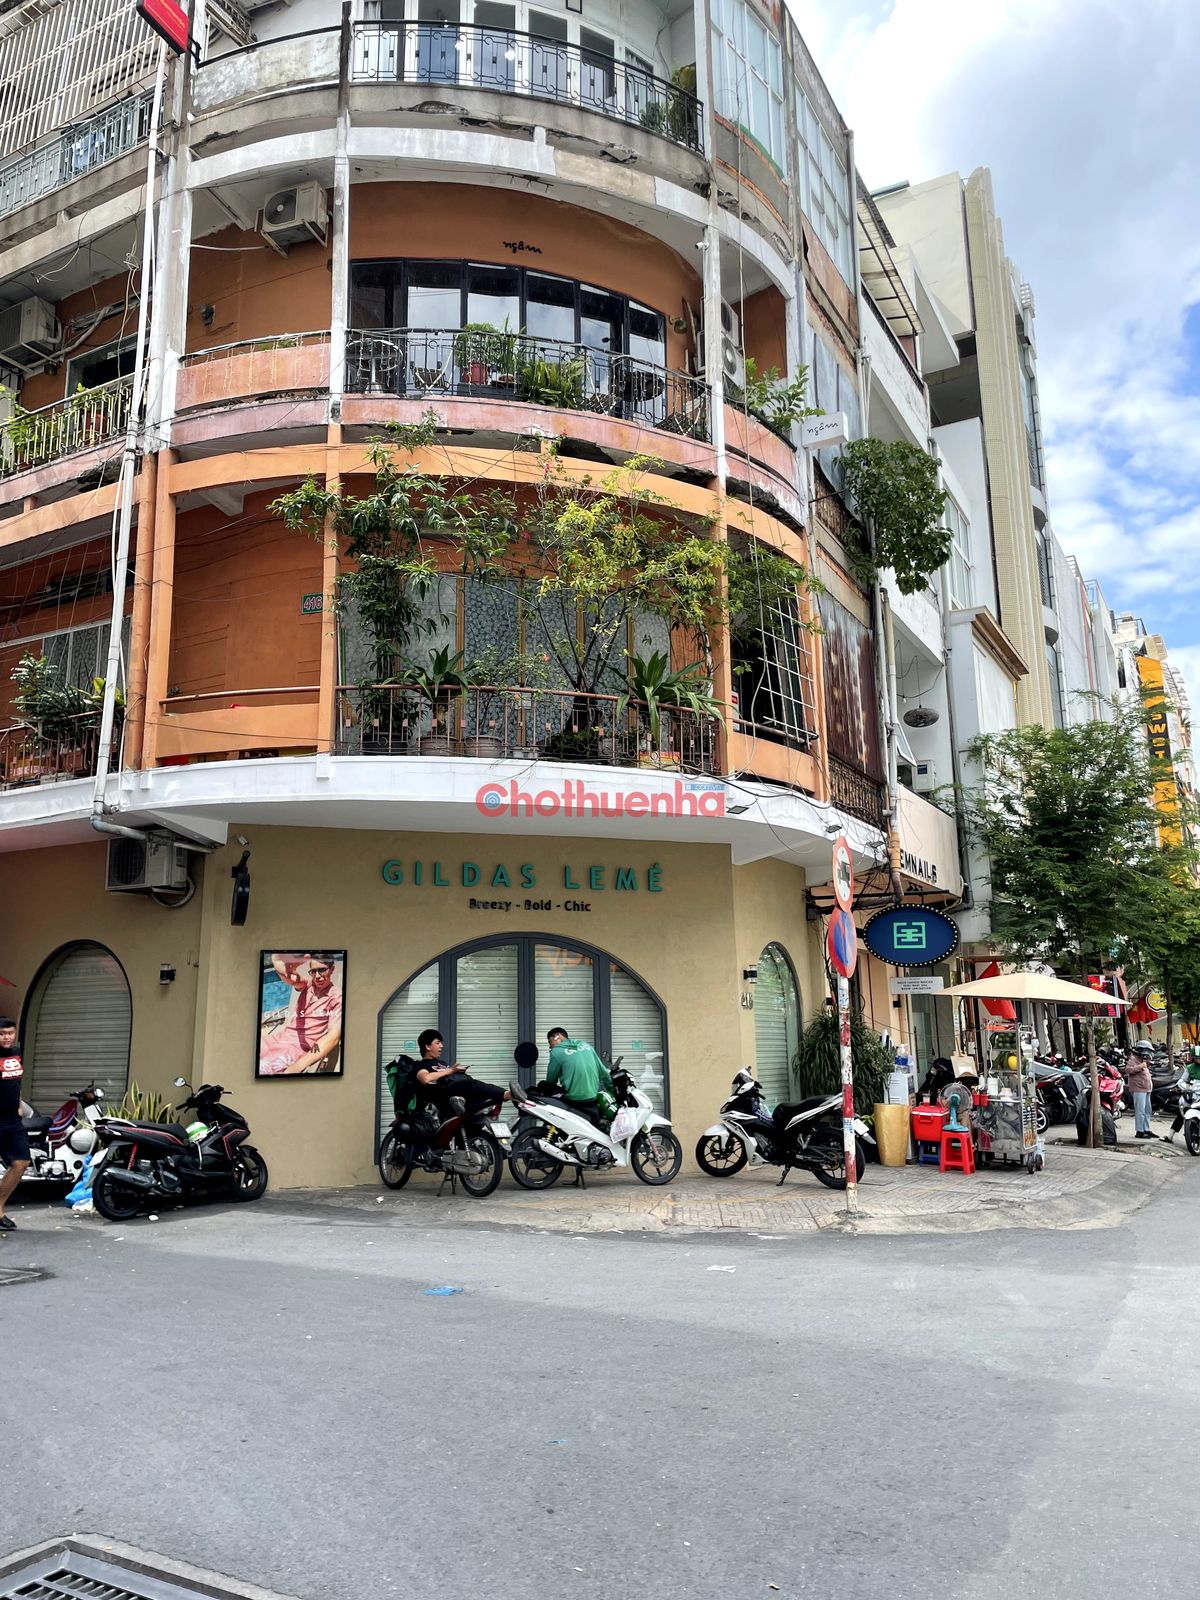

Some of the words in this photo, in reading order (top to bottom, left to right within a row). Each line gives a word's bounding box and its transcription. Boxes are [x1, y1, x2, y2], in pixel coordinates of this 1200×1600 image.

[806, 422, 839, 436] ngâm
[303, 596, 323, 610] 416
[382, 859, 537, 889] GILDAS
[565, 861, 664, 892] LEMÉ
[469, 898, 512, 912] Breezy
[525, 899, 552, 911] Bold
[564, 900, 592, 912] Chic
